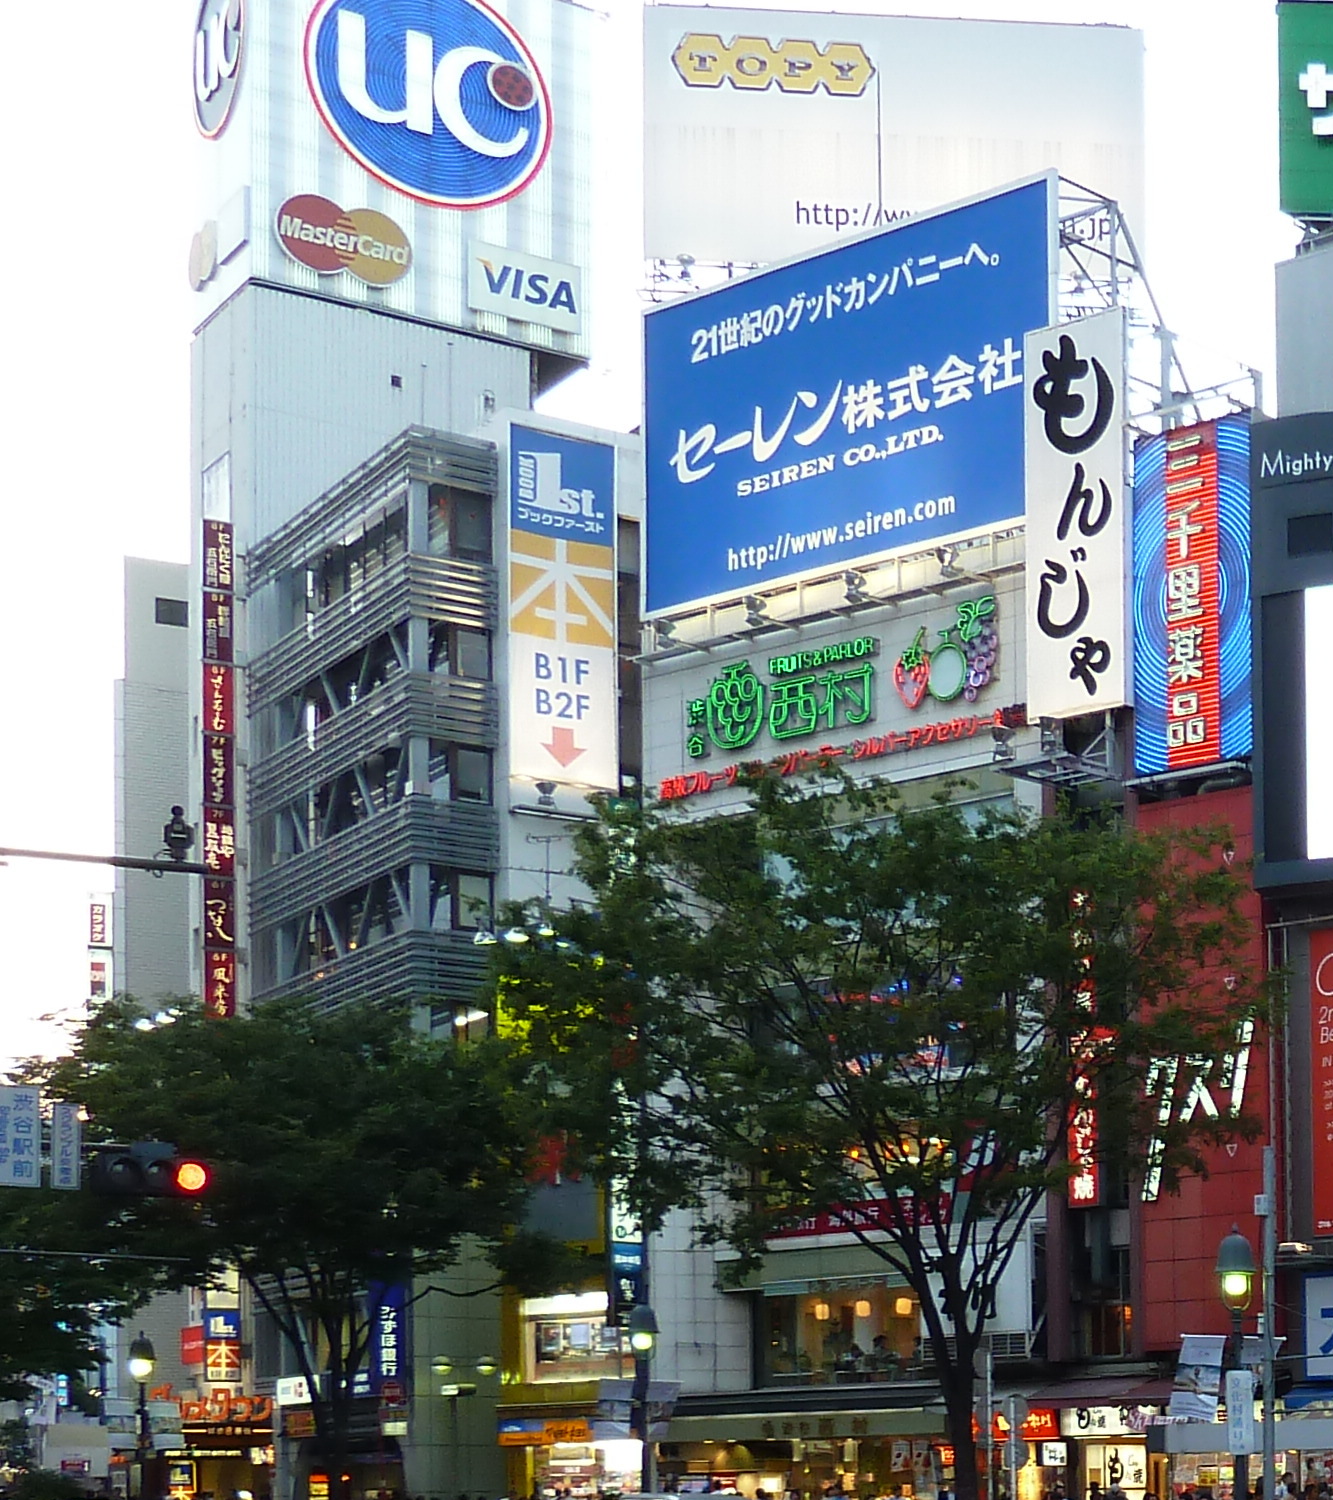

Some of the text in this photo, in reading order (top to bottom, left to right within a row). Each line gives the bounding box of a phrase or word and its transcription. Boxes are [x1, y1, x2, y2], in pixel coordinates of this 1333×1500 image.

[688, 38, 859, 82] TOPY
[280, 213, 412, 266] MasterCard
[476, 255, 578, 315] VISA
[690, 242, 1000, 365] 21世紀のグッドカンパニーへ。
[669, 338, 1023, 484] セーレン株式会社
[519, 454, 535, 499] BOOK
[736, 424, 944, 499] SEIREN CO.,LTD.
[1261, 447, 1333, 478] Mighty
[518, 506, 605, 534] ブックファースト
[727, 495, 957, 572] http://www.seiren.com
[1033, 333, 1116, 697] もんじゃ
[510, 538, 614, 647] 本
[1166, 435, 1207, 749] 三千里薬品
[534, 651, 590, 686] B1F
[535, 688, 590, 720] B2F
[686, 665, 875, 759] 渋谷 西村
[12, 1093, 35, 1179] 渋谷駅前
[207, 1340, 240, 1381] 本
